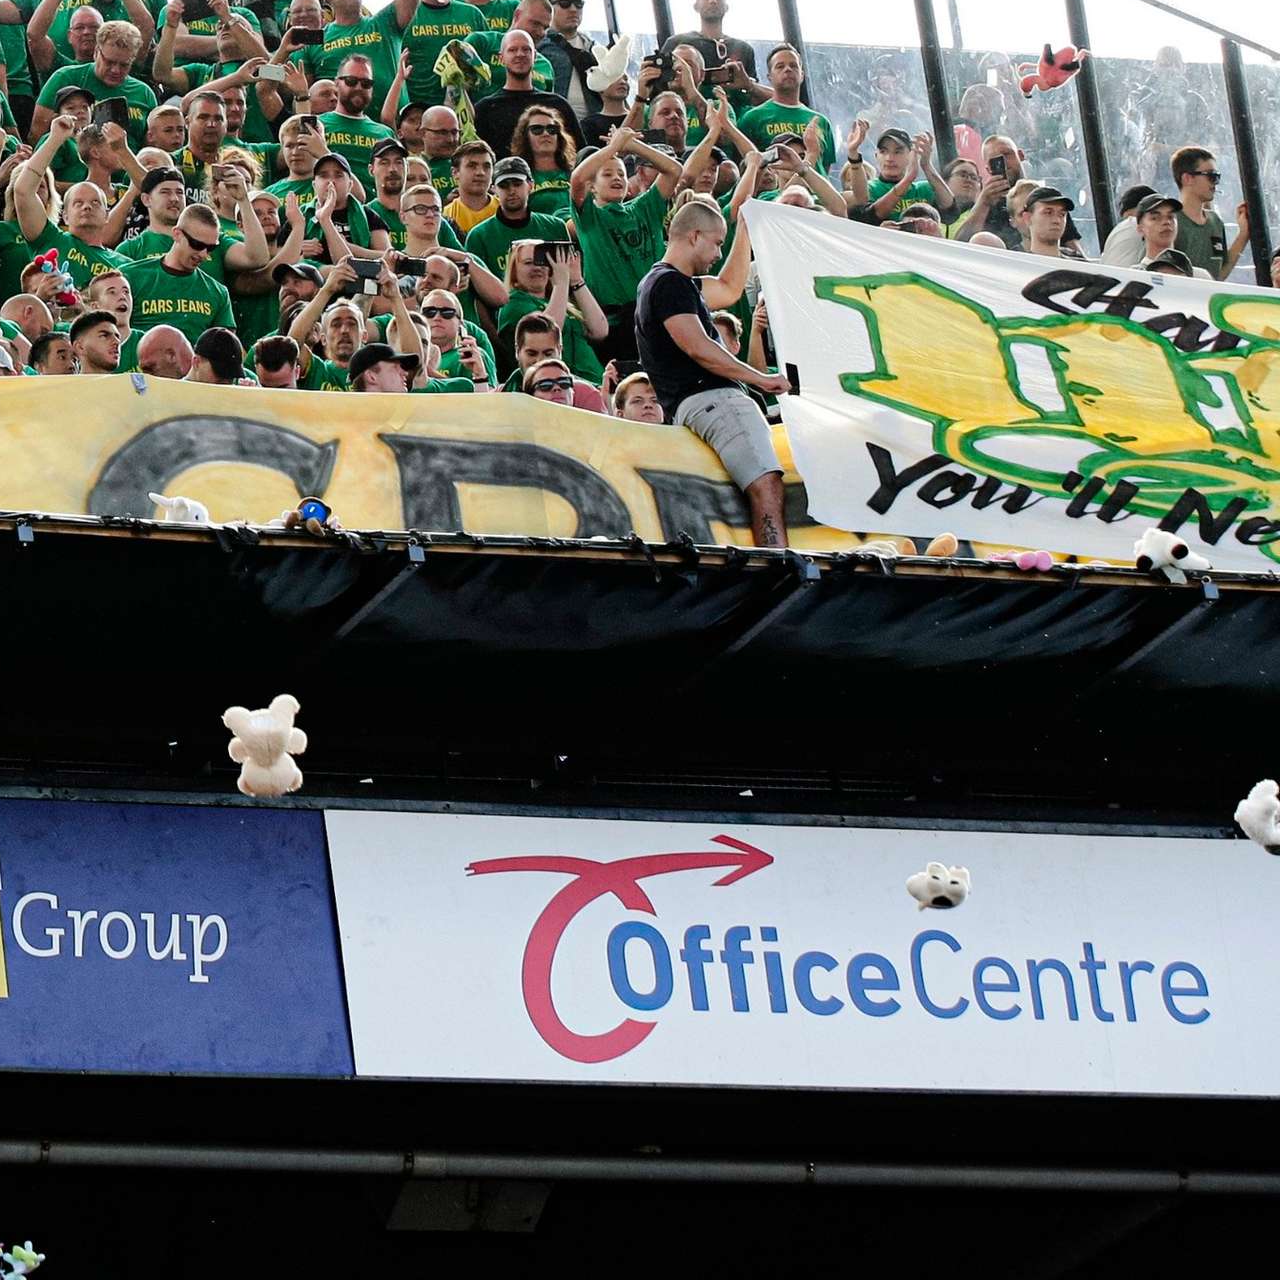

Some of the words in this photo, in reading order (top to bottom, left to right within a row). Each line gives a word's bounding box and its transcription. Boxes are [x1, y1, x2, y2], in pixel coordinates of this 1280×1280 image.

[412, 25, 440, 37] CARS
[441, 23, 472, 36] JEANS
[324, 38, 352, 53] CARS
[353, 32, 382, 47] JEANS
[766, 123, 794, 135] CARS
[324, 132, 352, 146] CARS
[142, 300, 173, 315] CARS
[176, 300, 212, 316] JEANS
[866, 441, 1140, 524] You'll
[1156, 487, 1280, 548] Ne
[12, 892, 228, 983] Group
[607, 920, 1212, 1026] OfficeCentre
